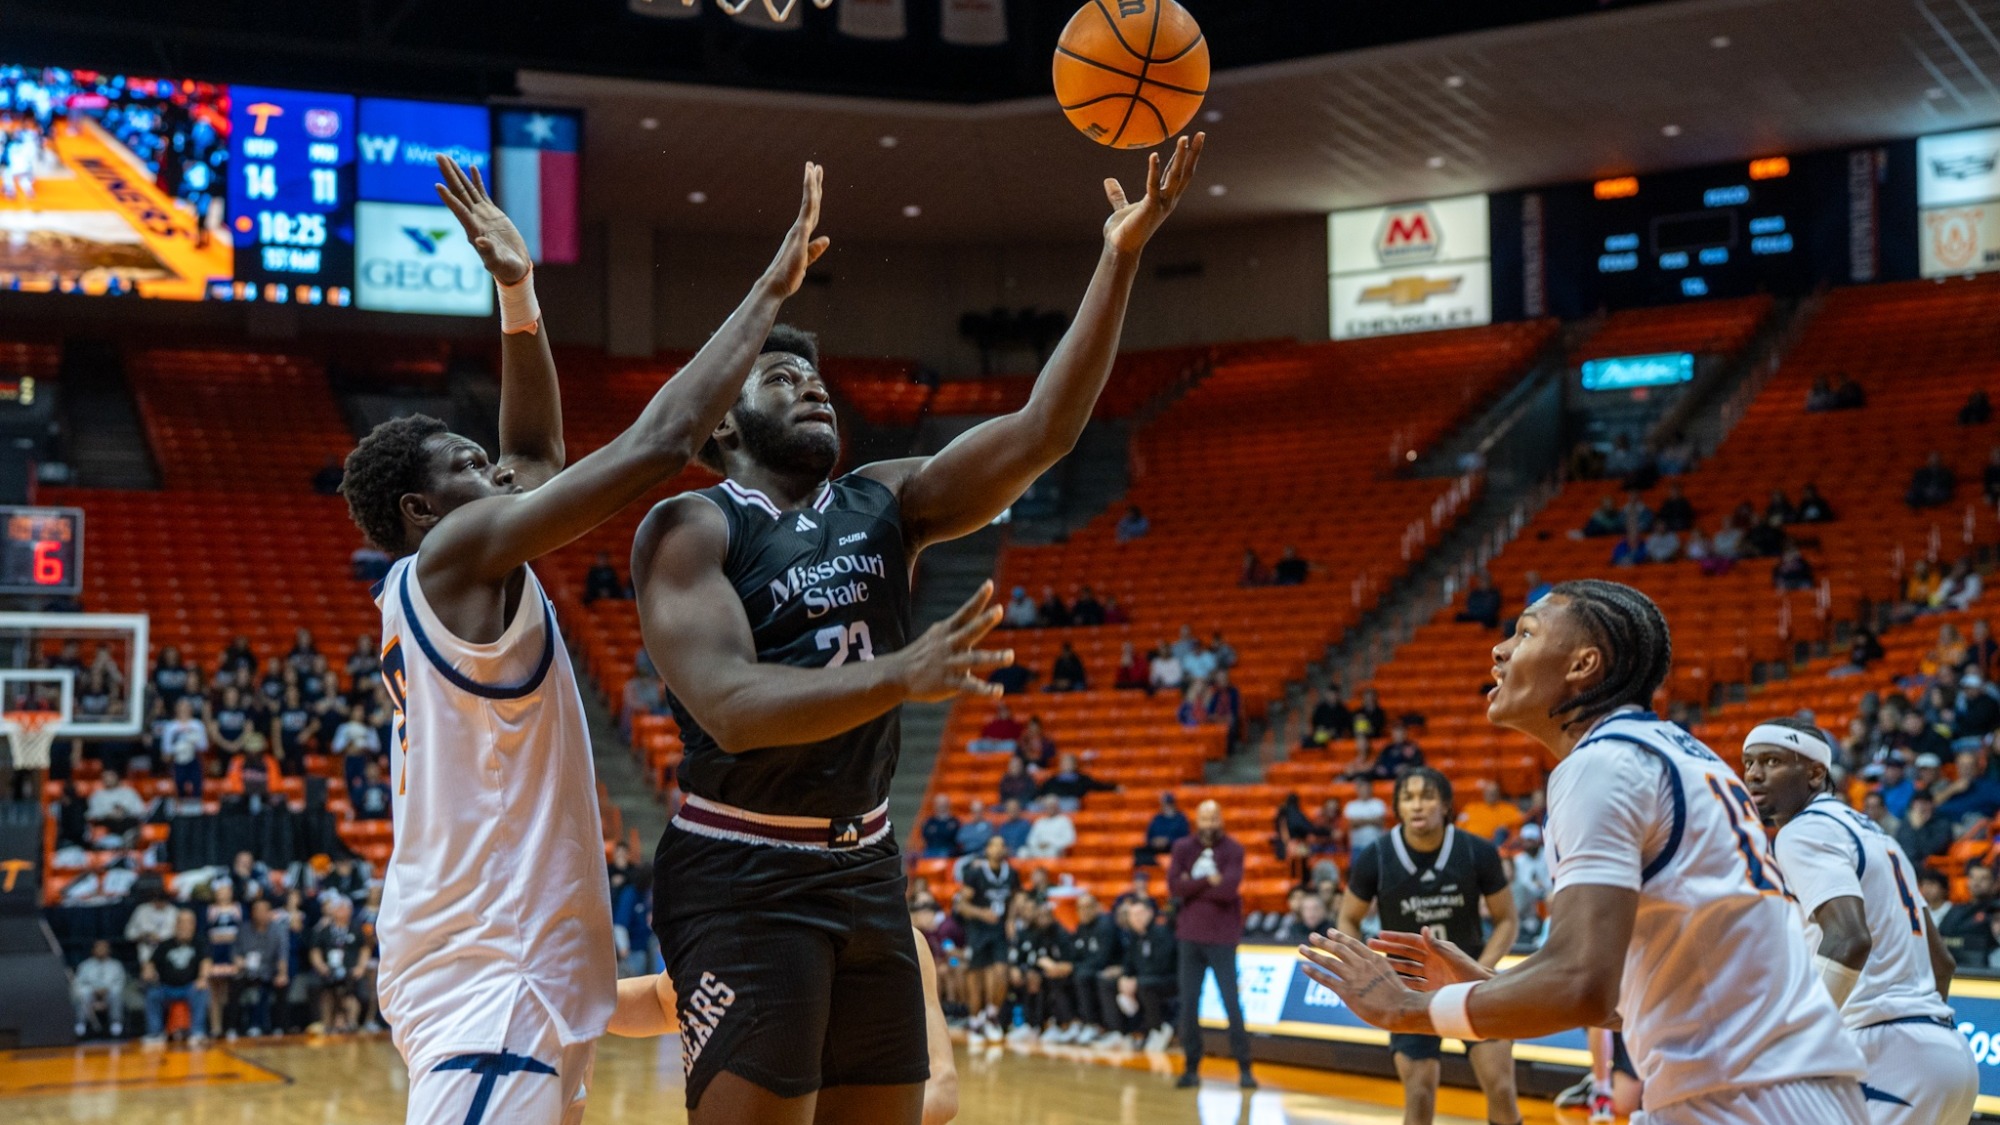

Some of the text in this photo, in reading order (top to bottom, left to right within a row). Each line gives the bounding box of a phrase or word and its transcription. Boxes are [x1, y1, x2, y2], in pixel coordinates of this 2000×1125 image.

[244, 163, 338, 206] 14 11
[258, 210, 327, 247] 10:25
[362, 259, 484, 294] GECU
[34, 540, 63, 585] 6
[768, 553, 885, 612] Missouri
[803, 578, 869, 619] State
[814, 620, 875, 669] 23
